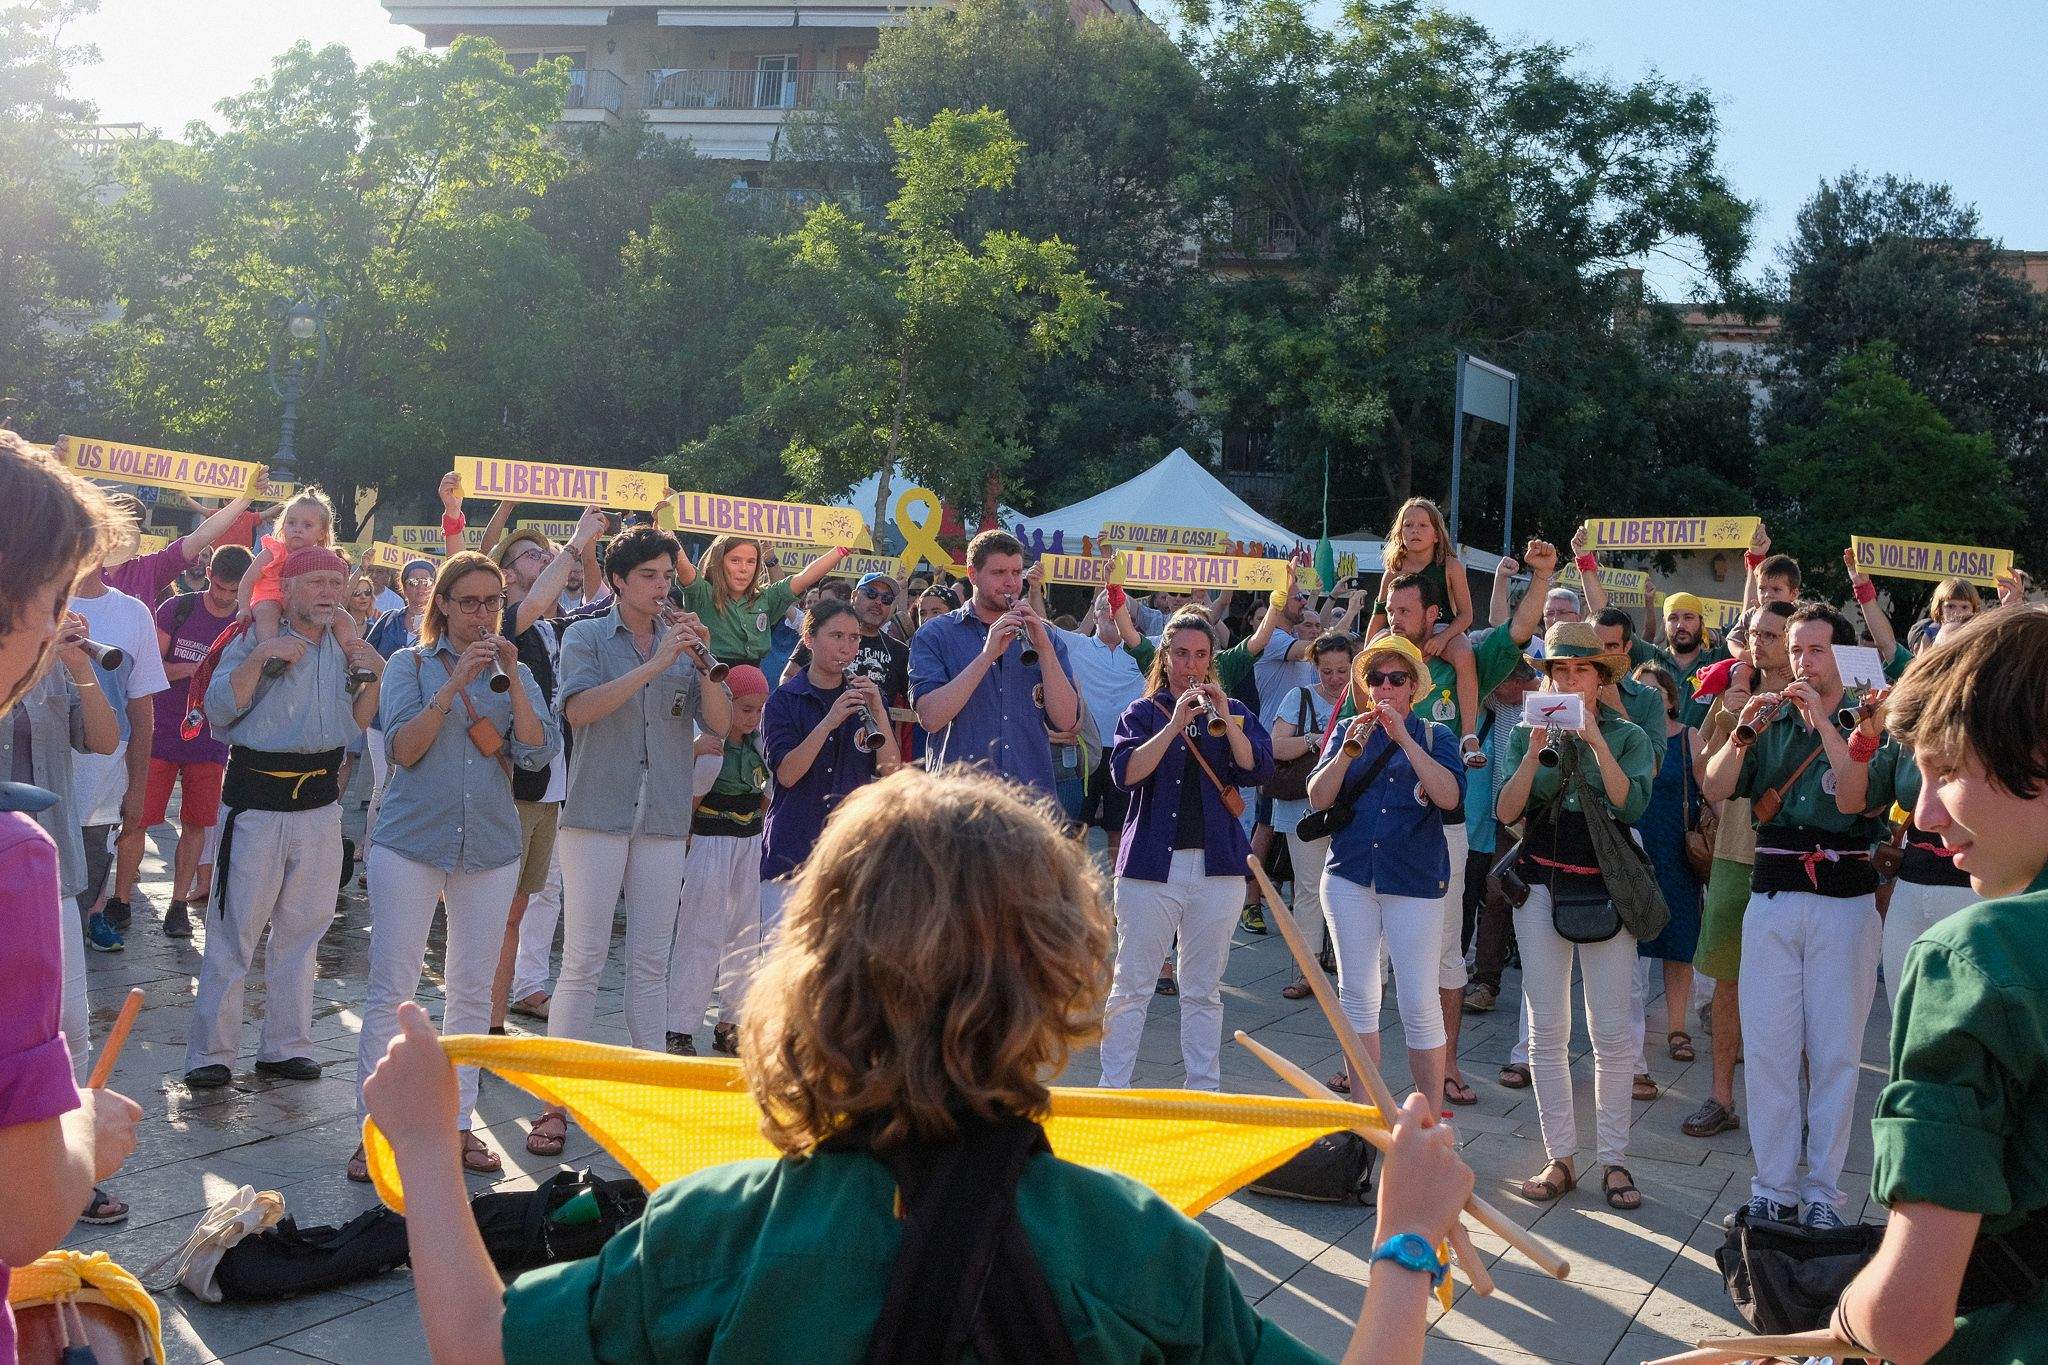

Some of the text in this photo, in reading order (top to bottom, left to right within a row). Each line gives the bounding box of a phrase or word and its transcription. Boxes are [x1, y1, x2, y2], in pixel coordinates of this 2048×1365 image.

[77, 443, 248, 489] US VOLEM A CASA!
[475, 461, 608, 501] LLIBERTAT!
[679, 495, 813, 538] LLIBERTAT!
[403, 529, 446, 542] US VOL
[1109, 525, 1217, 547] US VOLEM A CASA!
[1597, 520, 1706, 544] LLIBERTAT!
[382, 546, 399, 562] US
[782, 551, 798, 566] US
[845, 558, 854, 571] A
[856, 558, 892, 575] CASA!
[1857, 542, 1995, 577] US VOLEM A CASA!
[1126, 553, 1239, 585] LLIBERTAT!
[1607, 572, 1614, 584] A
[1615, 572, 1640, 587] CASA!
[1607, 591, 1643, 604] BERTAT!
